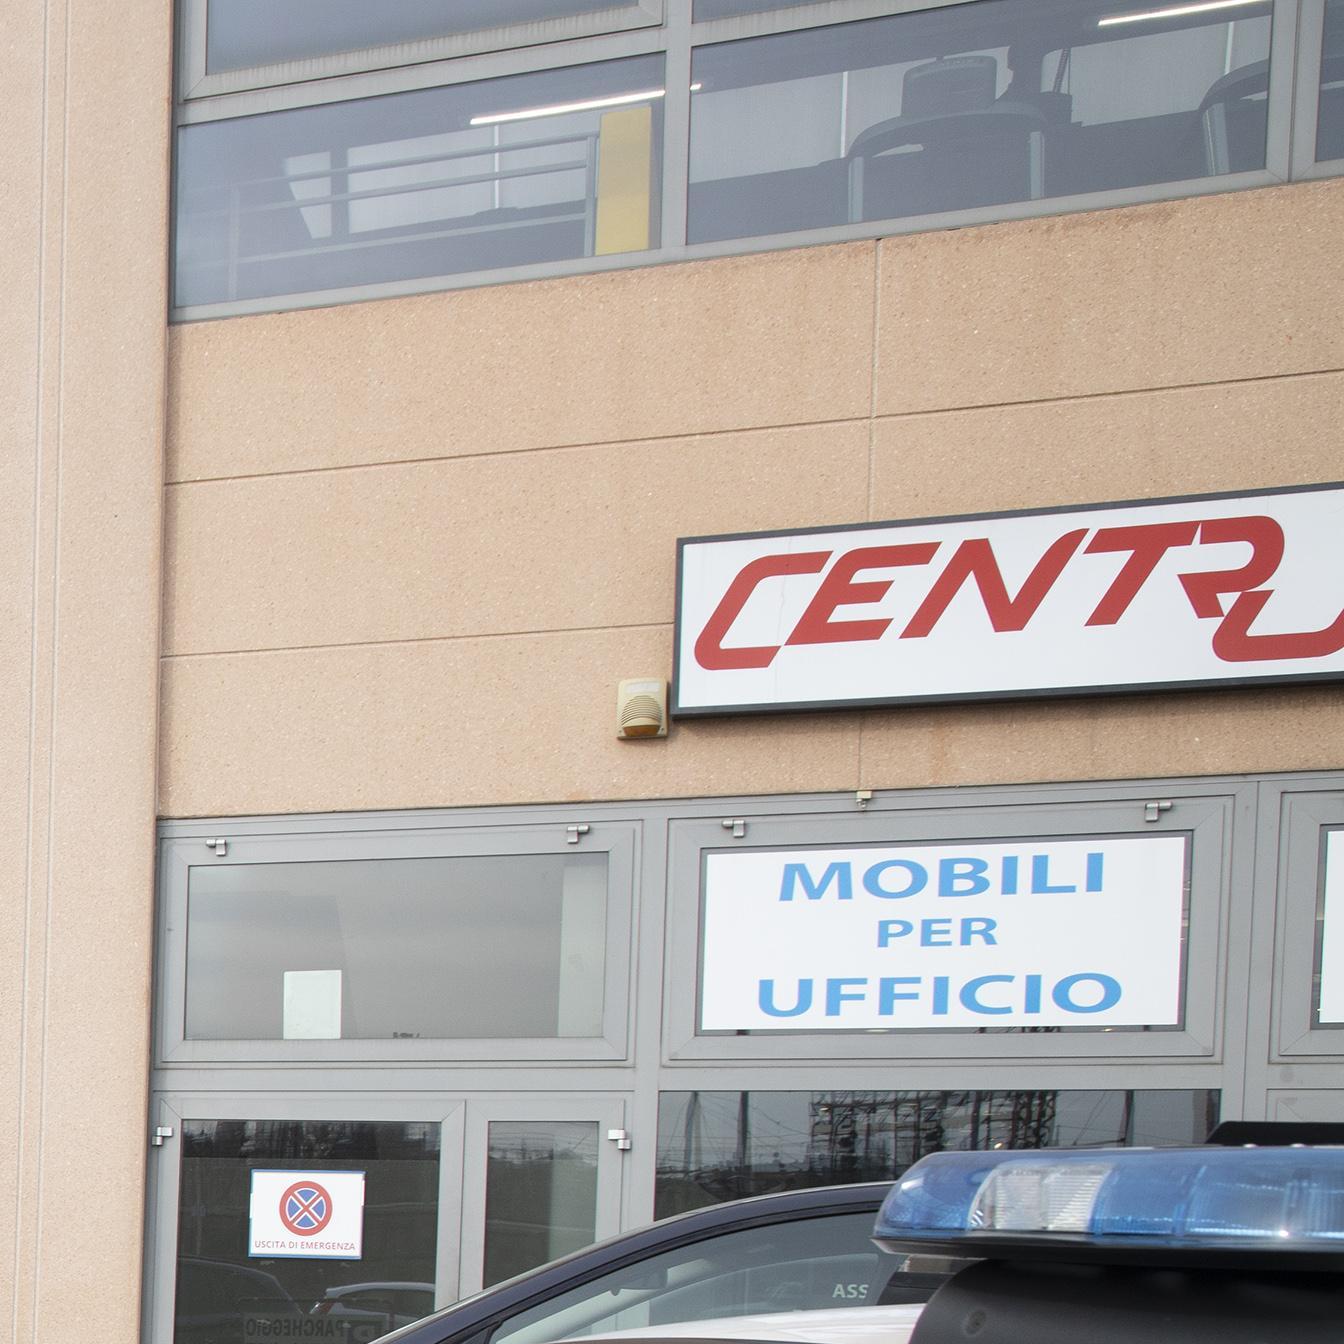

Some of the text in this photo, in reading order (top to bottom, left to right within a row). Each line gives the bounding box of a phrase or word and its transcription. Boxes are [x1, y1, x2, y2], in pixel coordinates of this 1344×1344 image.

[778, 852, 1104, 902] MOBILI
[877, 917, 998, 948] PER
[757, 972, 1123, 1018] UFFICIO
[254, 1240, 356, 1250] USCITA DI EMERGENZA
